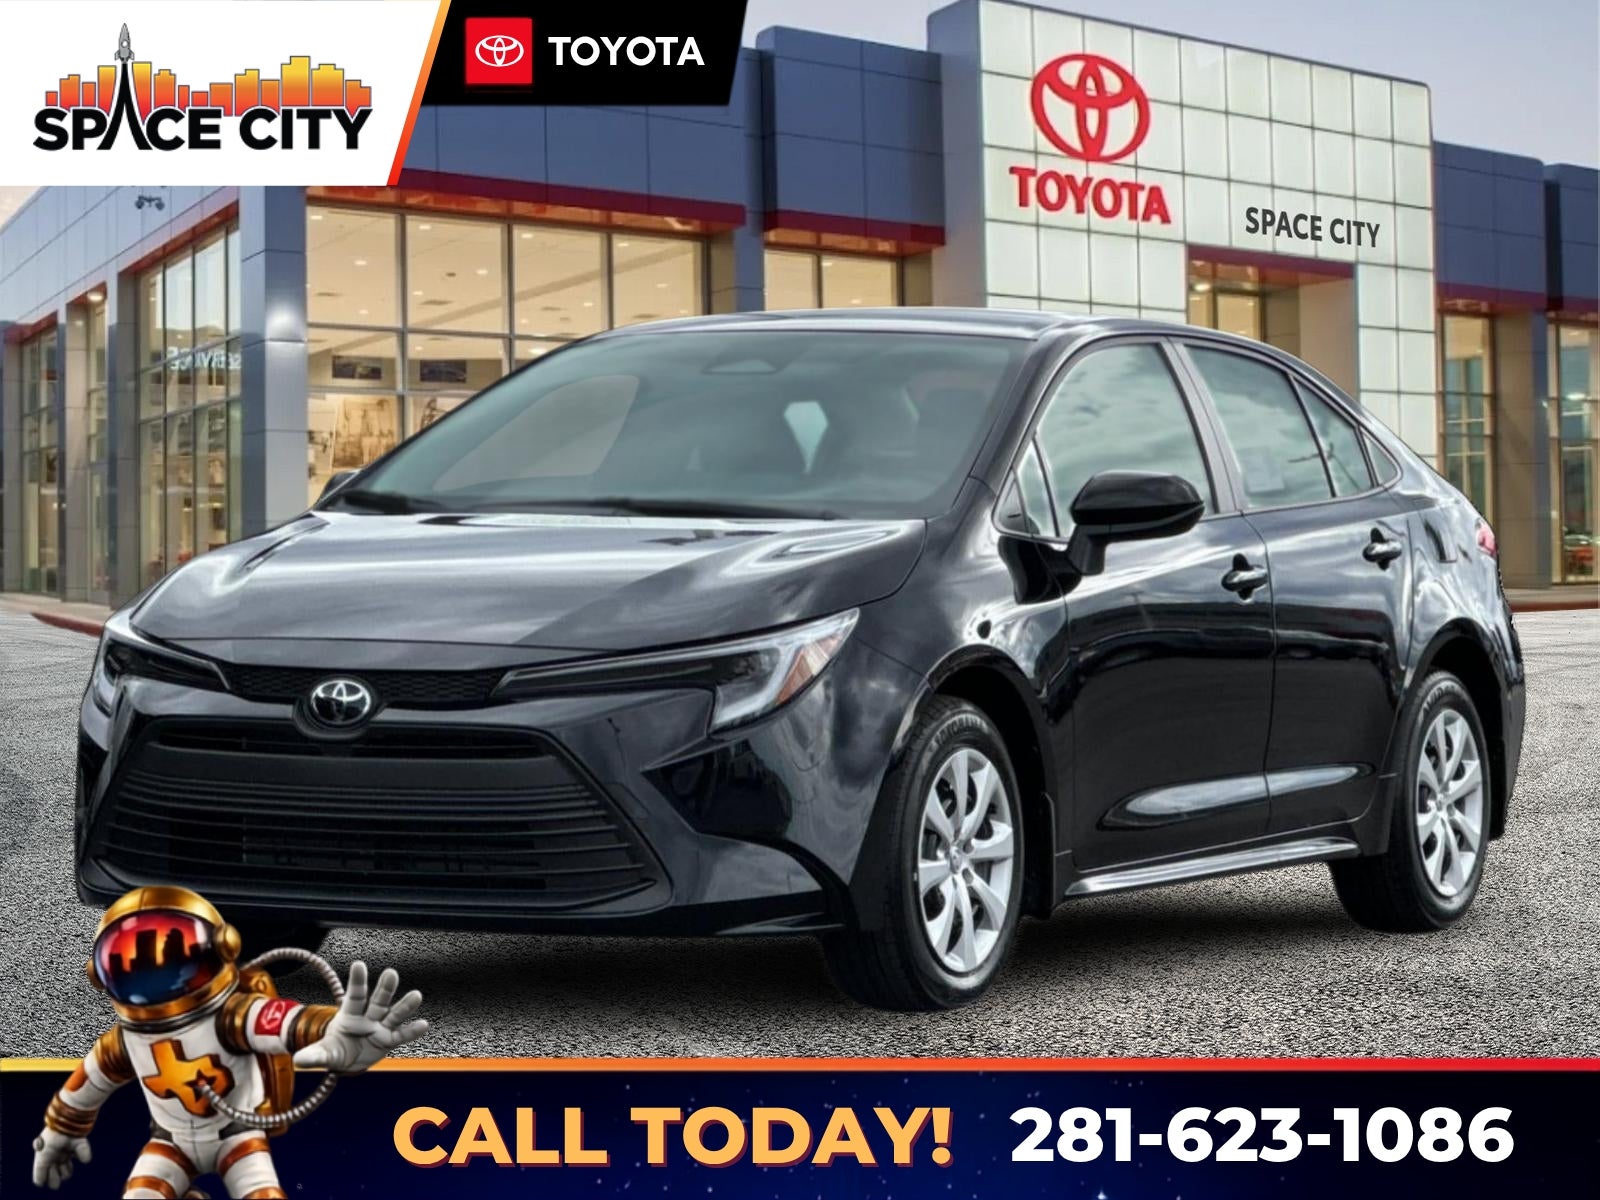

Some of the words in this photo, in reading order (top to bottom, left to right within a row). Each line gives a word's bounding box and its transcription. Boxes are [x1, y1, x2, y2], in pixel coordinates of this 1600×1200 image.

[1009, 166, 1172, 224] TOYOTA
[1245, 206, 1323, 242] SPACE
[1329, 217, 1381, 248] CITY
